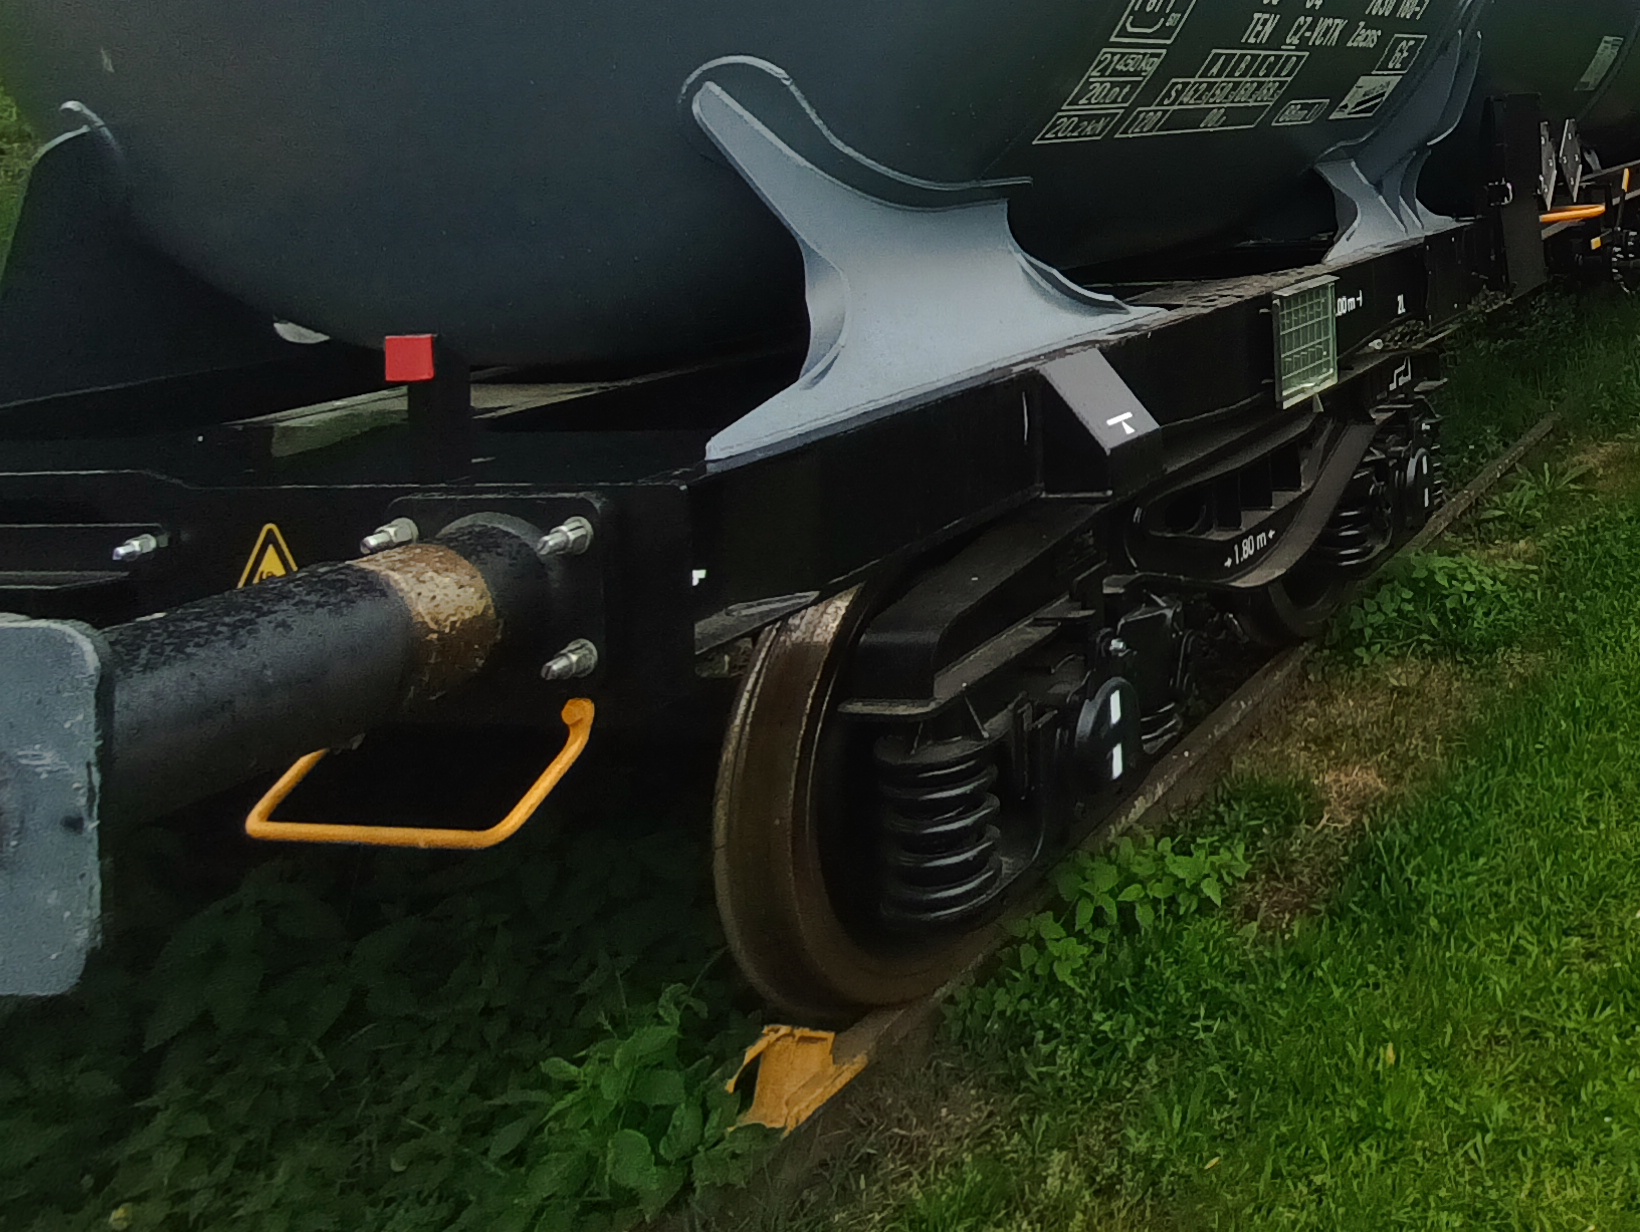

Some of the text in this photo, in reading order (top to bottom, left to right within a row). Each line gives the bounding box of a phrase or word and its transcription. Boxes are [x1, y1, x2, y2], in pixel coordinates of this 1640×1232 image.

[1241, 12, 1280, 44] TEN
[1284, 15, 1349, 48] CZ-VCTK
[1208, 55, 1226, 76] A
[1234, 55, 1251, 76] B
[1258, 55, 1275, 76] C
[1164, 83, 1182, 105] S
[1128, 111, 1163, 134] 120
[1234, 535, 1255, 565] 1.80
